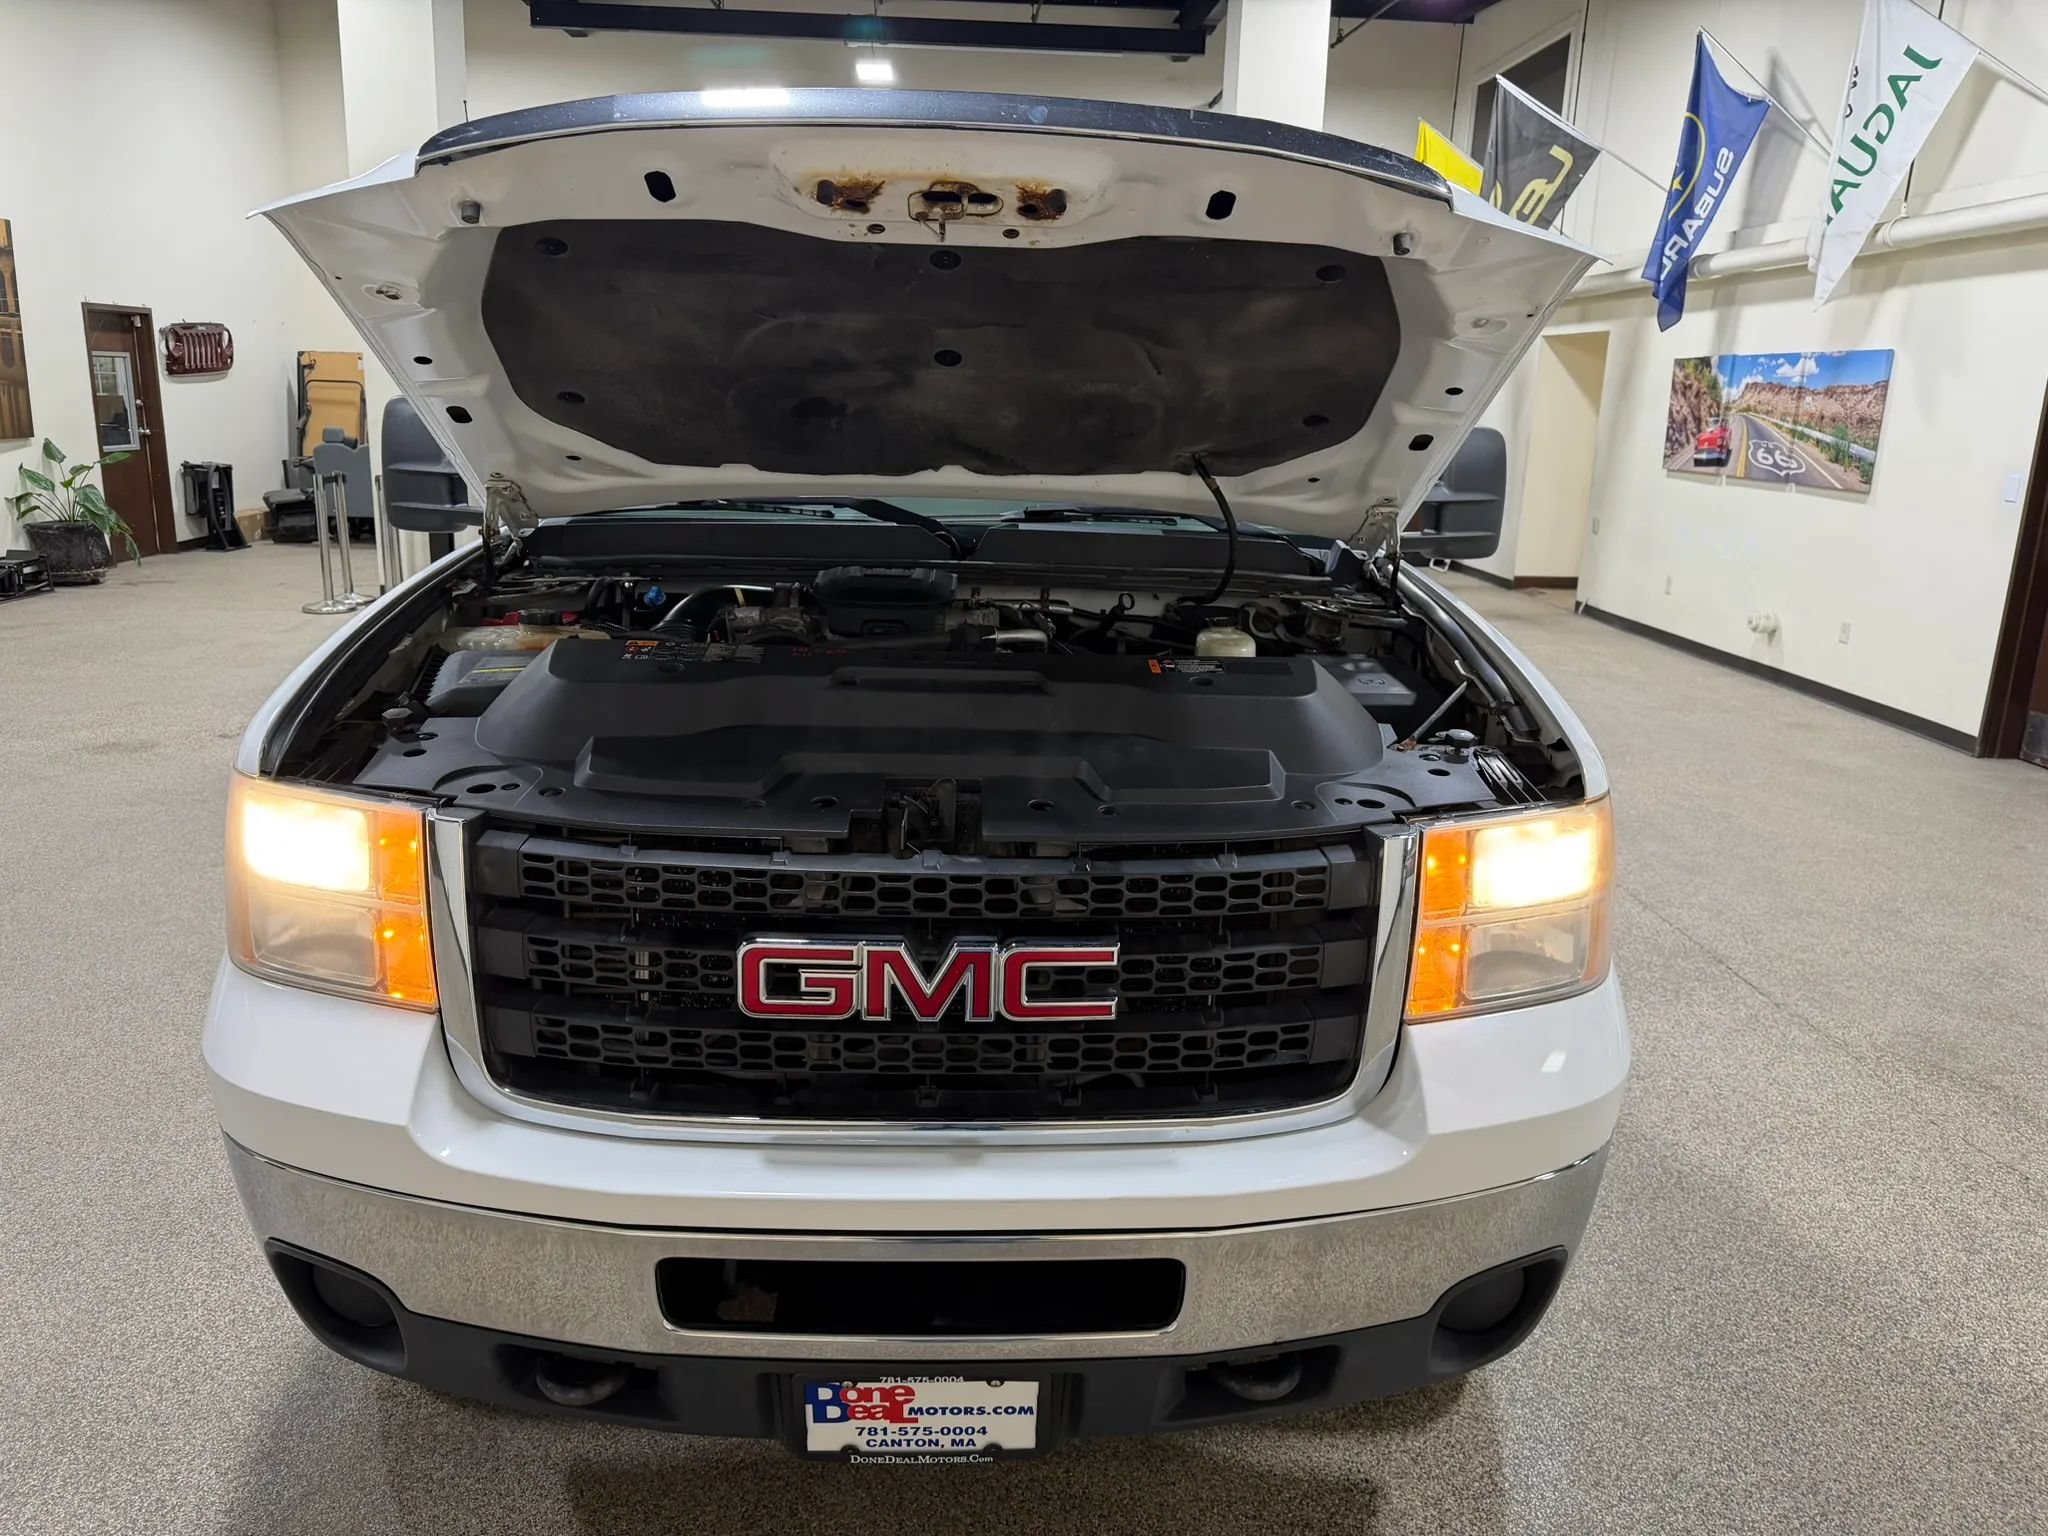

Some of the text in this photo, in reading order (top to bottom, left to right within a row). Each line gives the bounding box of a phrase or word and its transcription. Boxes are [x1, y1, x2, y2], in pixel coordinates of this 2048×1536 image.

[1756, 447, 1798, 469] 66
[736, 935, 1120, 1022] GMC
[805, 1382, 916, 1405] Done
[907, 1406, 1035, 1416] MOTORS.COM
[855, 1426, 988, 1437] 781-575-0004
[865, 1438, 977, 1449] CANTON, MA
